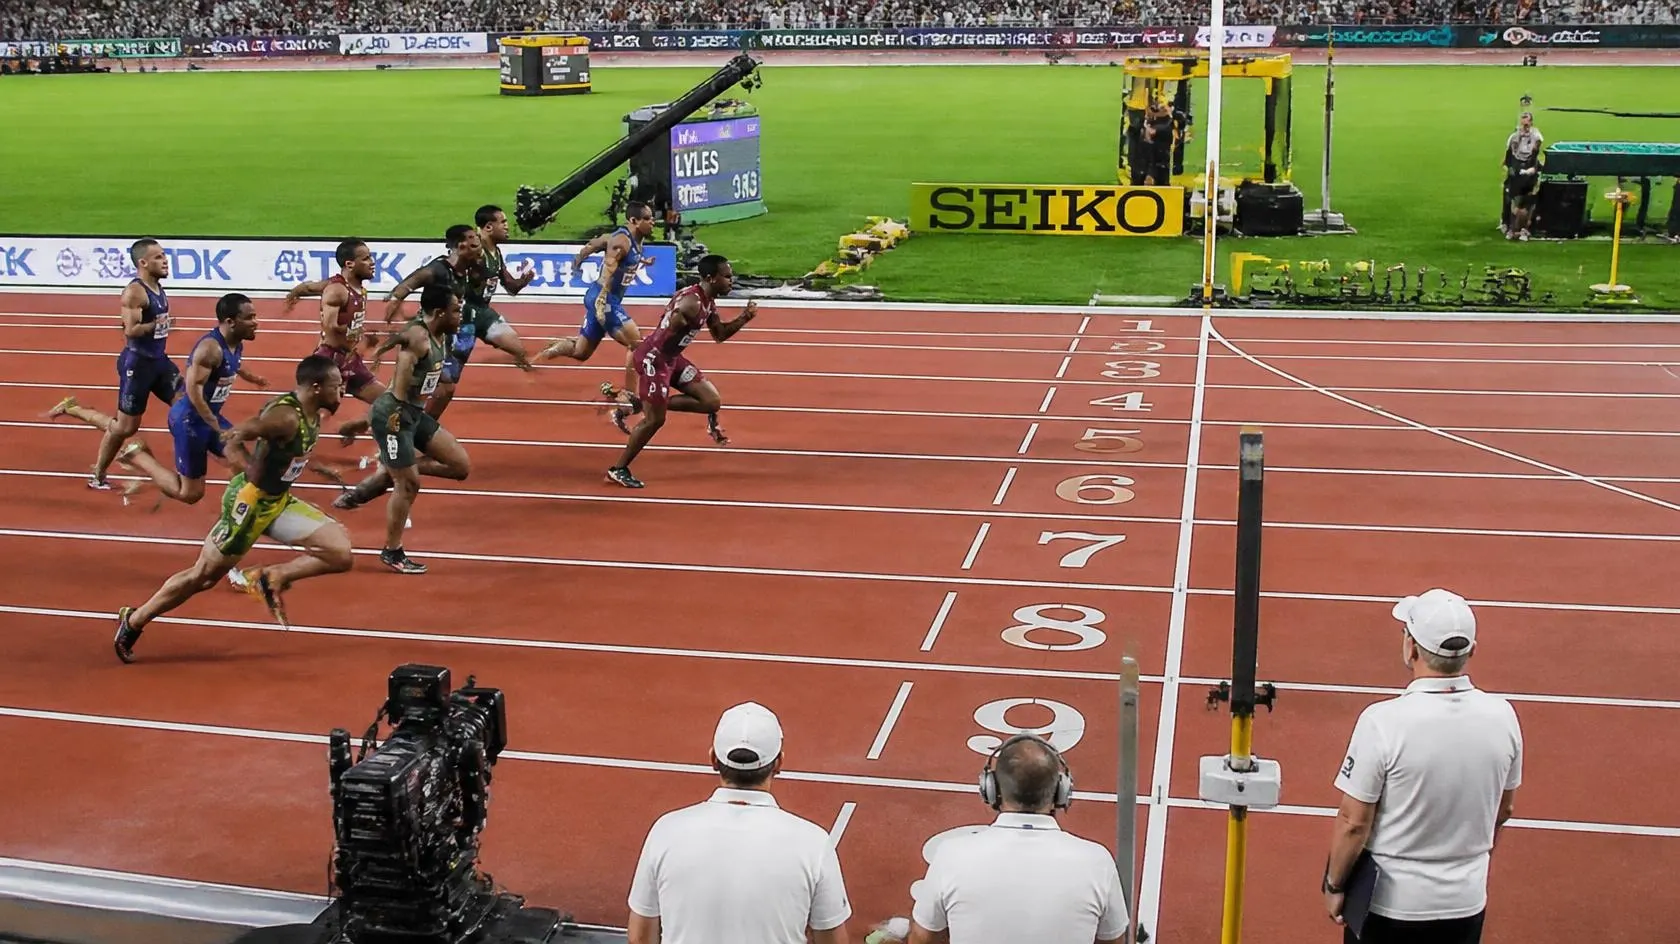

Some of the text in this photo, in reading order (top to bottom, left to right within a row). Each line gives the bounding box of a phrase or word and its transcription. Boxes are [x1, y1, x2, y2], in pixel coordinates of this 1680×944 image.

[675, 150, 719, 177] LYLES
[929, 187, 1165, 233] SEIKO
[1119, 320, 1165, 332] 1
[1100, 360, 1160, 379] 3
[1089, 391, 1153, 411] 4
[1074, 428, 1144, 454] 5
[1055, 474, 1136, 505] 6
[1037, 531, 1127, 568] 7
[1000, 603, 1108, 651] 8
[966, 697, 1086, 757] 9
